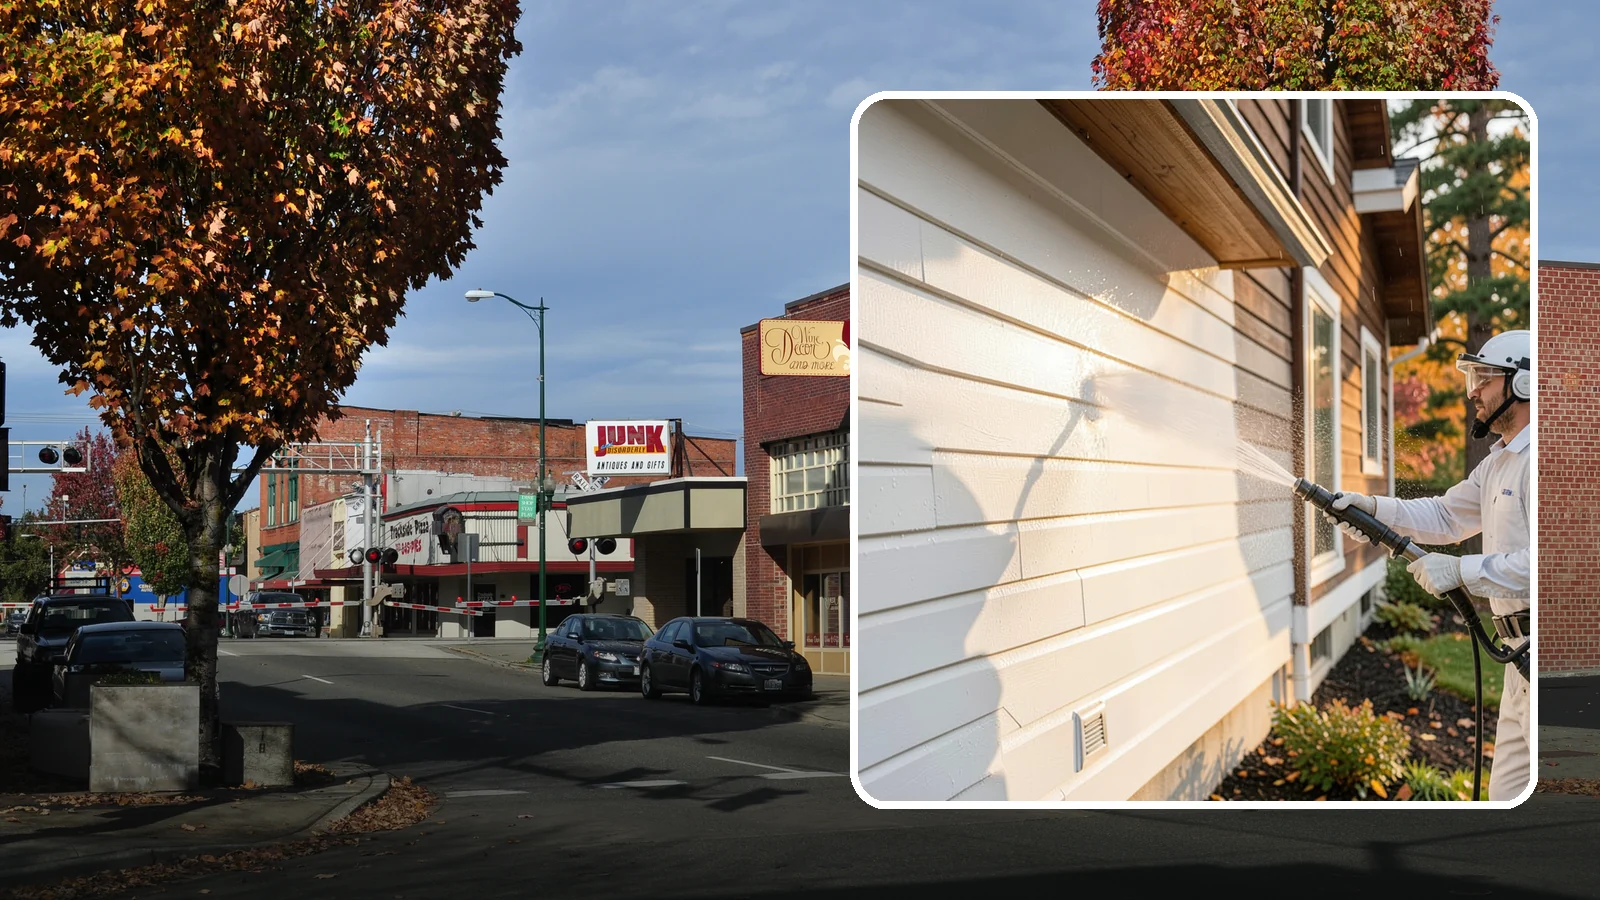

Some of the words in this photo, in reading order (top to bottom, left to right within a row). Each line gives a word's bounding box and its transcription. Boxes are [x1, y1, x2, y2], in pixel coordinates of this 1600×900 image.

[596, 425, 664, 457] JUNK
[607, 446, 646, 454] DISORDERLY
[596, 461, 628, 470] ANTIQUES
[631, 461, 644, 470] AND
[647, 460, 666, 470] GIFTS
[414, 519, 429, 534] Pizza
